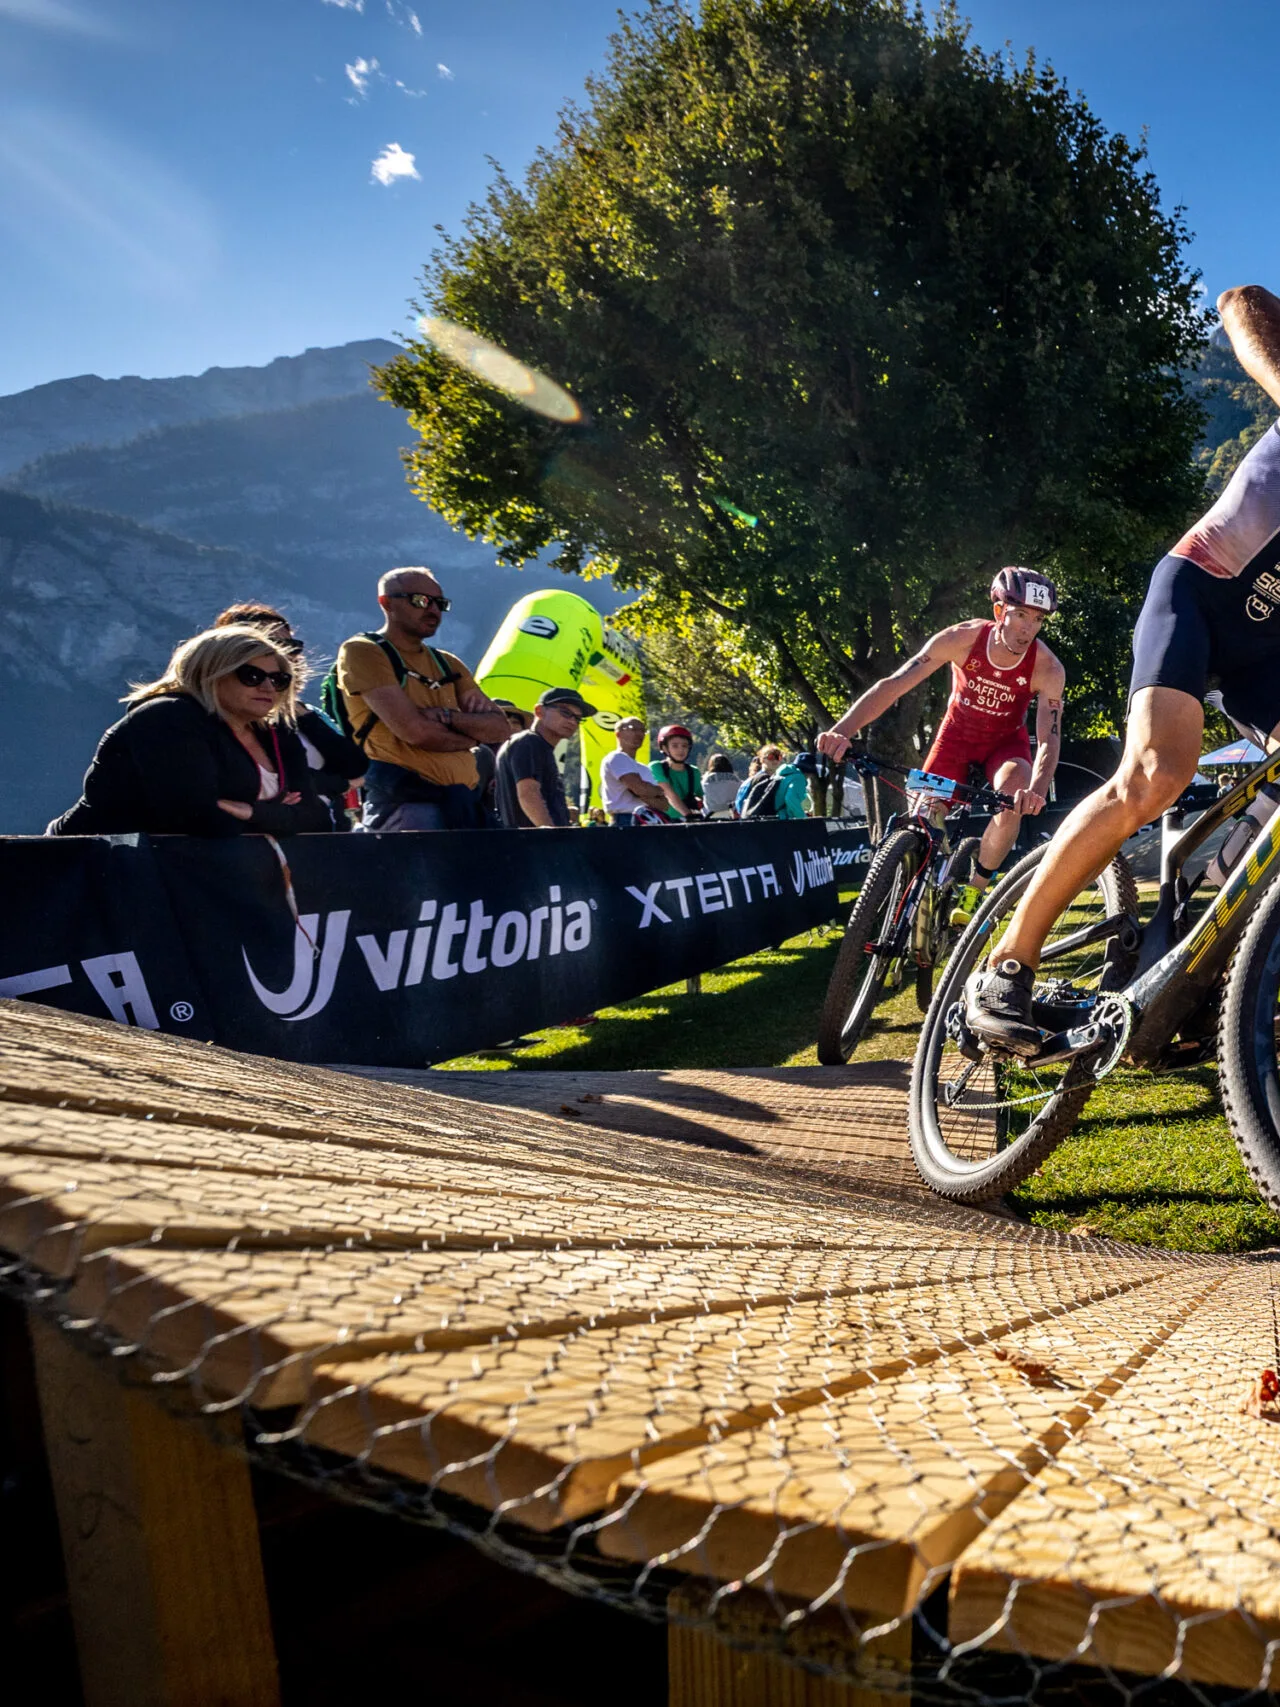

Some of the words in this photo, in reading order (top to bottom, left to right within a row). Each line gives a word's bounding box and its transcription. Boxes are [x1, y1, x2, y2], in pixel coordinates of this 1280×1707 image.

[1033, 588, 1045, 599] 14
[968, 679, 1016, 703] DAFFLON
[976, 695, 1001, 709] SUI
[625, 862, 781, 929] XTERRA
[355, 885, 592, 992] vittoria
